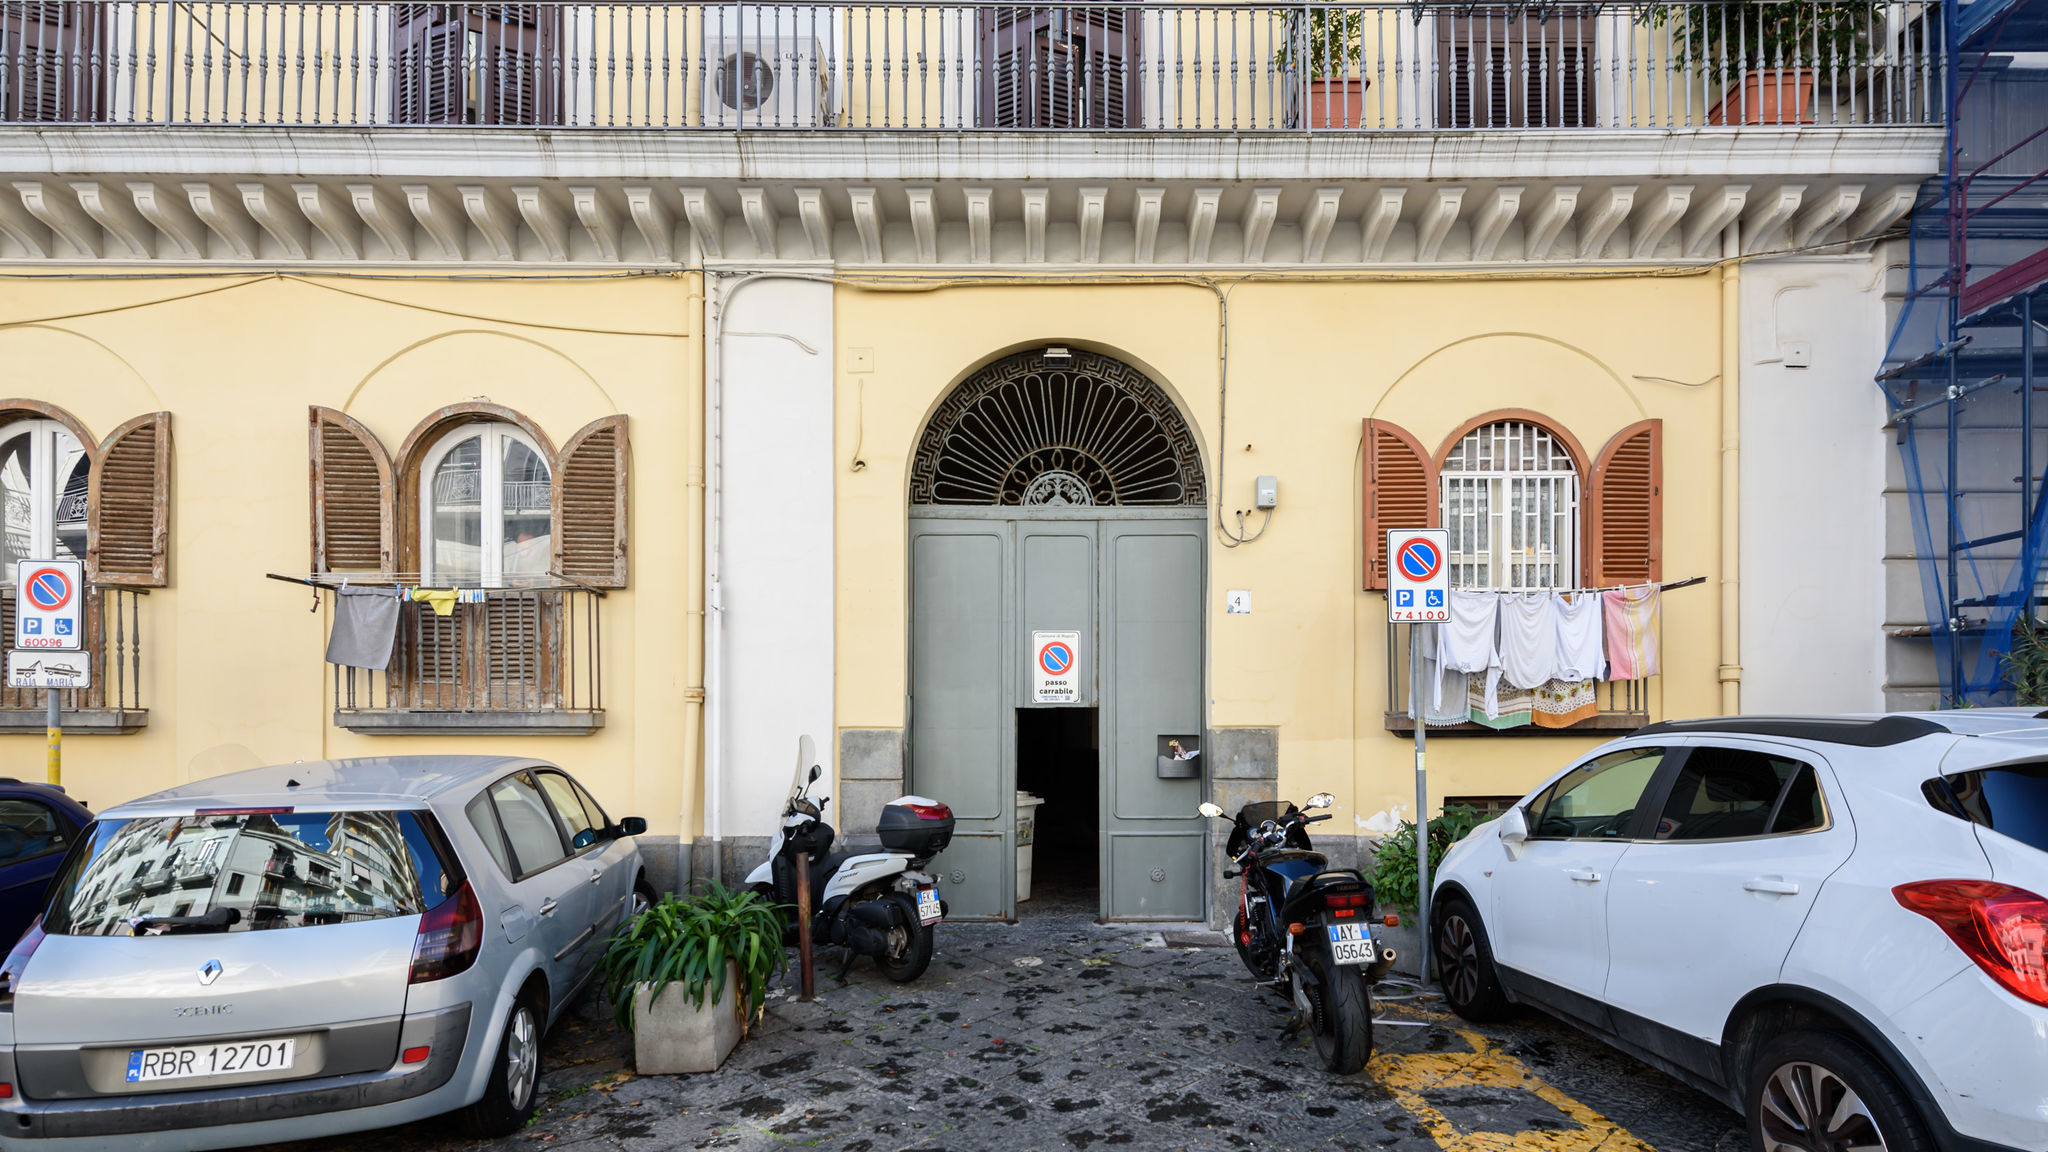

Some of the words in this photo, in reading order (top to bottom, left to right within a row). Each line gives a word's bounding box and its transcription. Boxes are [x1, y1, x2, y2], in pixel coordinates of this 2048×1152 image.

[1234, 596, 1241, 607] 4
[1395, 611, 1445, 621] 74100
[24, 638, 63, 648] 60096
[46, 677, 74, 687] MARIA
[920, 902, 940, 918] 57145
[1340, 925, 1353, 940] AY
[1334, 942, 1372, 960] 05643
[174, 1004, 233, 1017] SCENIC
[128, 1068, 139, 1077] PL
[142, 1050, 196, 1077] RBR
[208, 1042, 286, 1072] 12701
